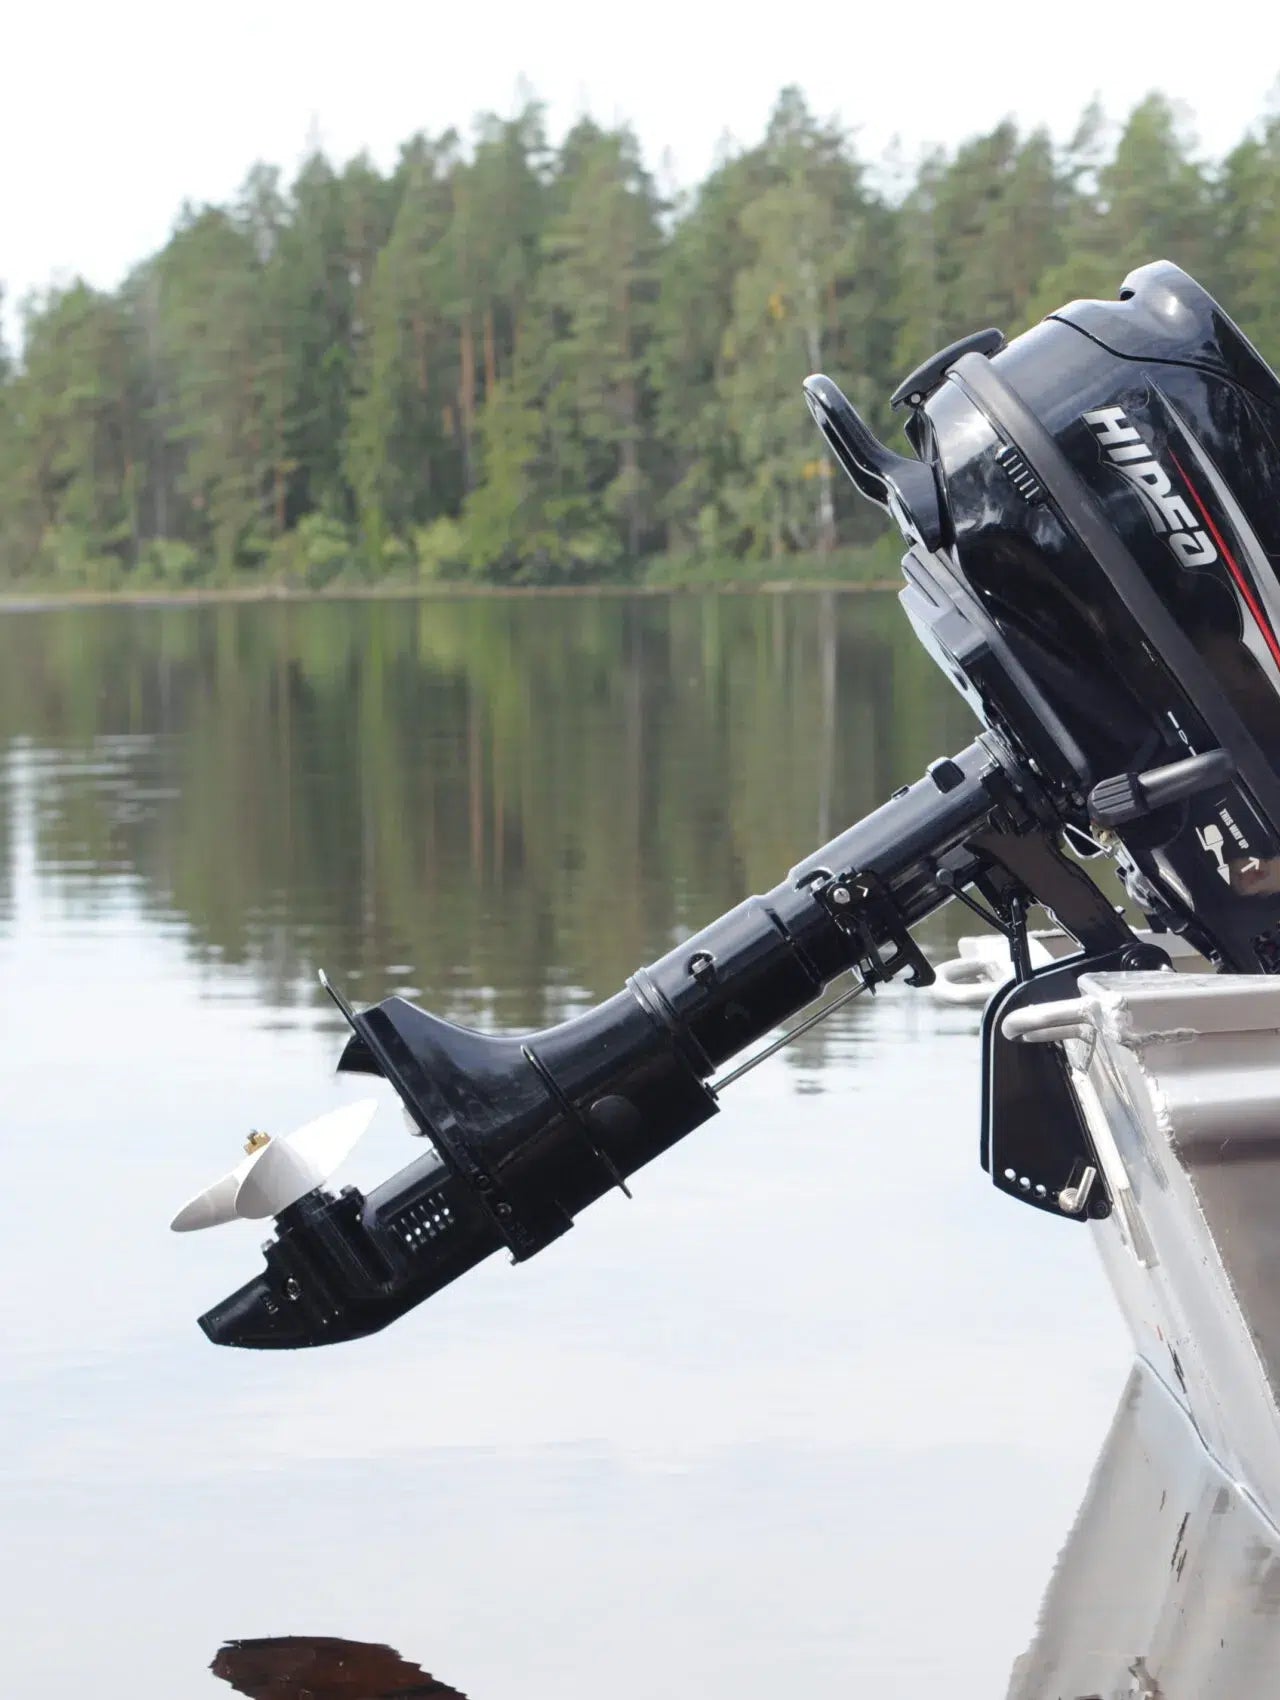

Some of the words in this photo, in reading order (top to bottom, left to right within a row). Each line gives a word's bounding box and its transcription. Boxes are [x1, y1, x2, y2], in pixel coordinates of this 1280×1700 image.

[1219, 808, 1234, 826] THIS
[1229, 823, 1243, 840] WAY
[1238, 838, 1249, 849] UP
